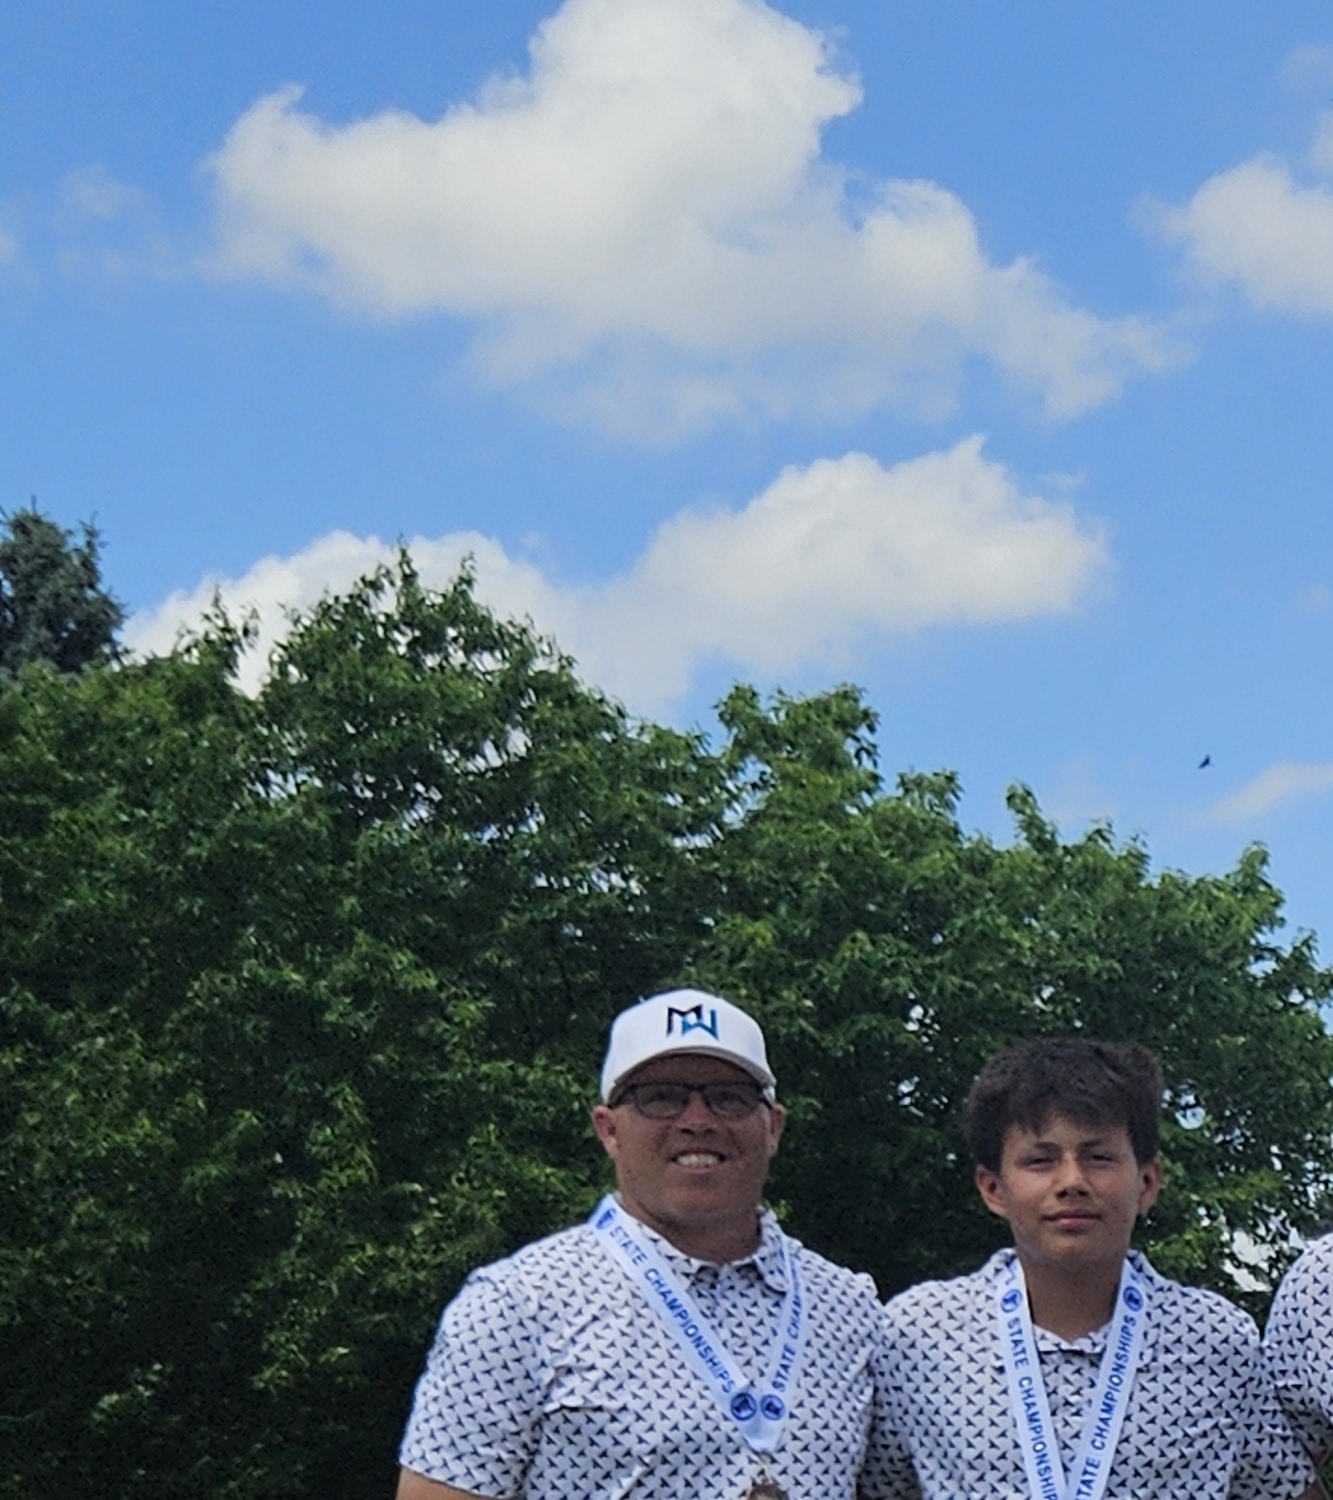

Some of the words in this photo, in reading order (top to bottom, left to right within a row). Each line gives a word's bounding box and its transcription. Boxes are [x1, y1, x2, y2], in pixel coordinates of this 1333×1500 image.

[610, 1226, 648, 1266] STATE
[644, 1268, 736, 1394] CHAMPIONSHIPS
[1007, 1317, 1029, 1370] STATE
[772, 1344, 796, 1392] STATE
[1091, 1315, 1137, 1451] CHAMPIONSHIPS
